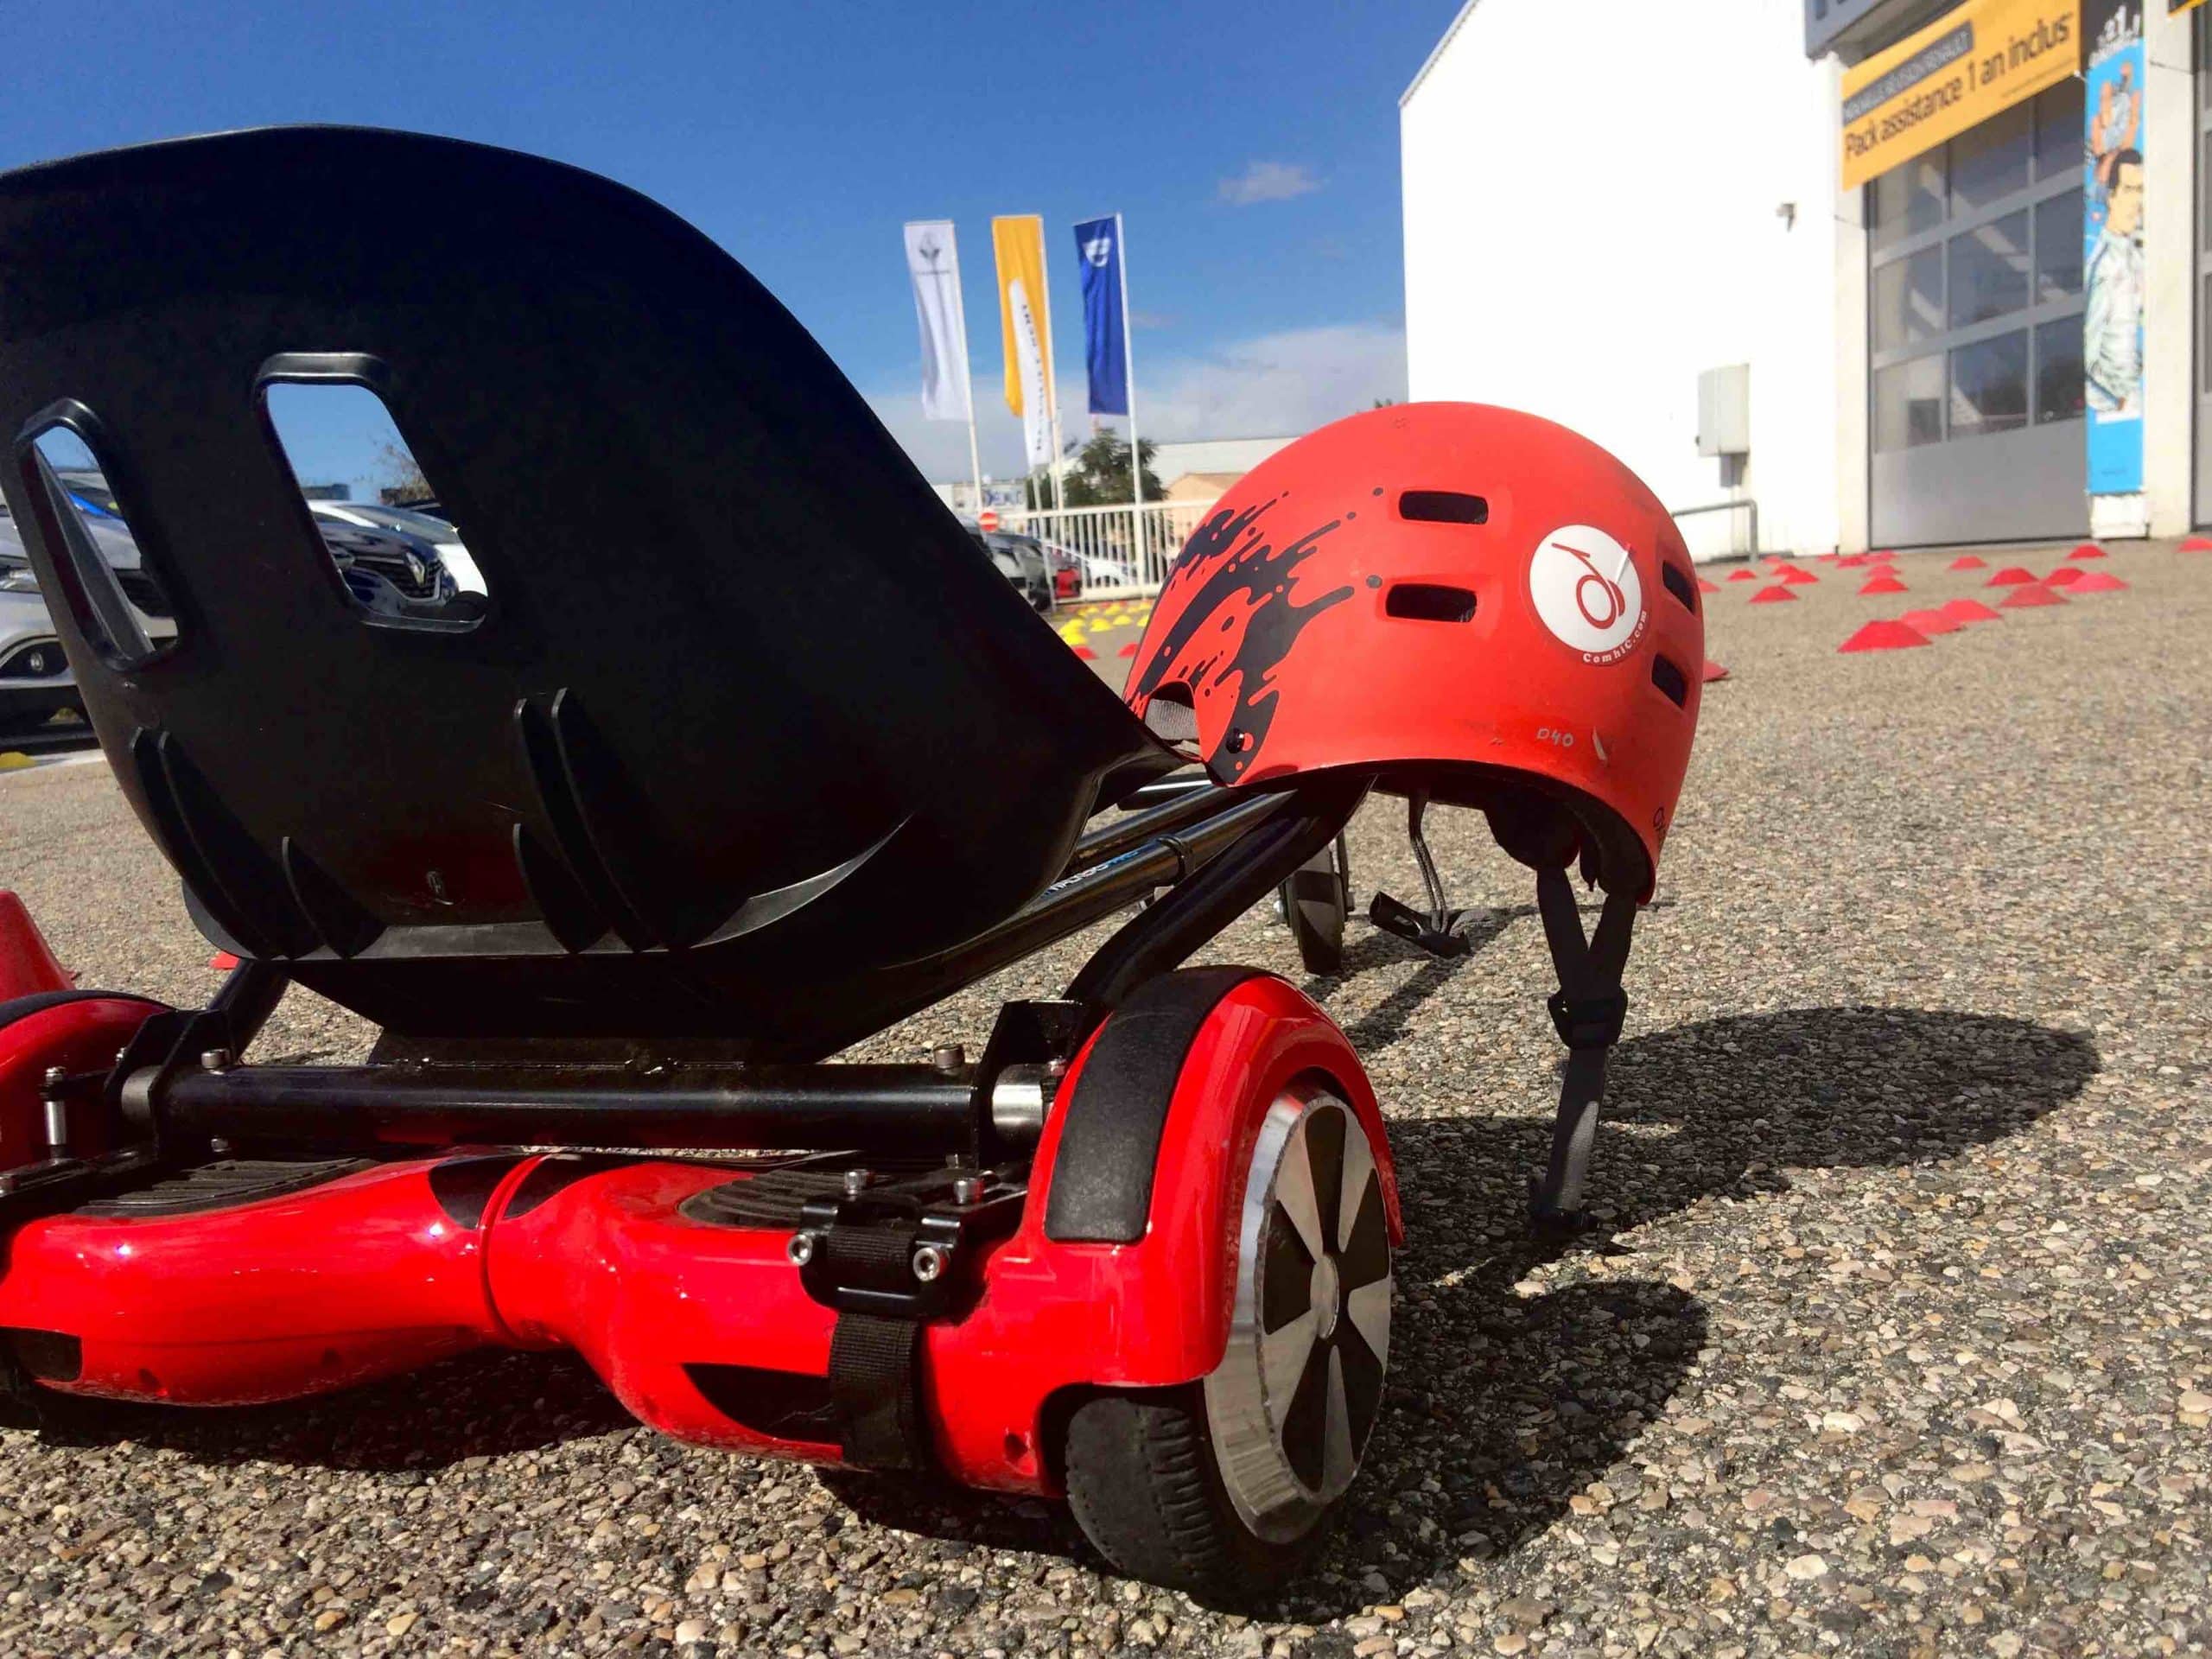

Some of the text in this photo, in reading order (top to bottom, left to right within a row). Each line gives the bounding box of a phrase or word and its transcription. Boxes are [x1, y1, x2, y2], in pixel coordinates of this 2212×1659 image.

[1845, 117, 1878, 162] Pack
[1881, 76, 1963, 141] assistance
[1967, 60, 1977, 92] 1
[1980, 52, 2005, 85] an
[2008, 12, 2071, 69] inclus
